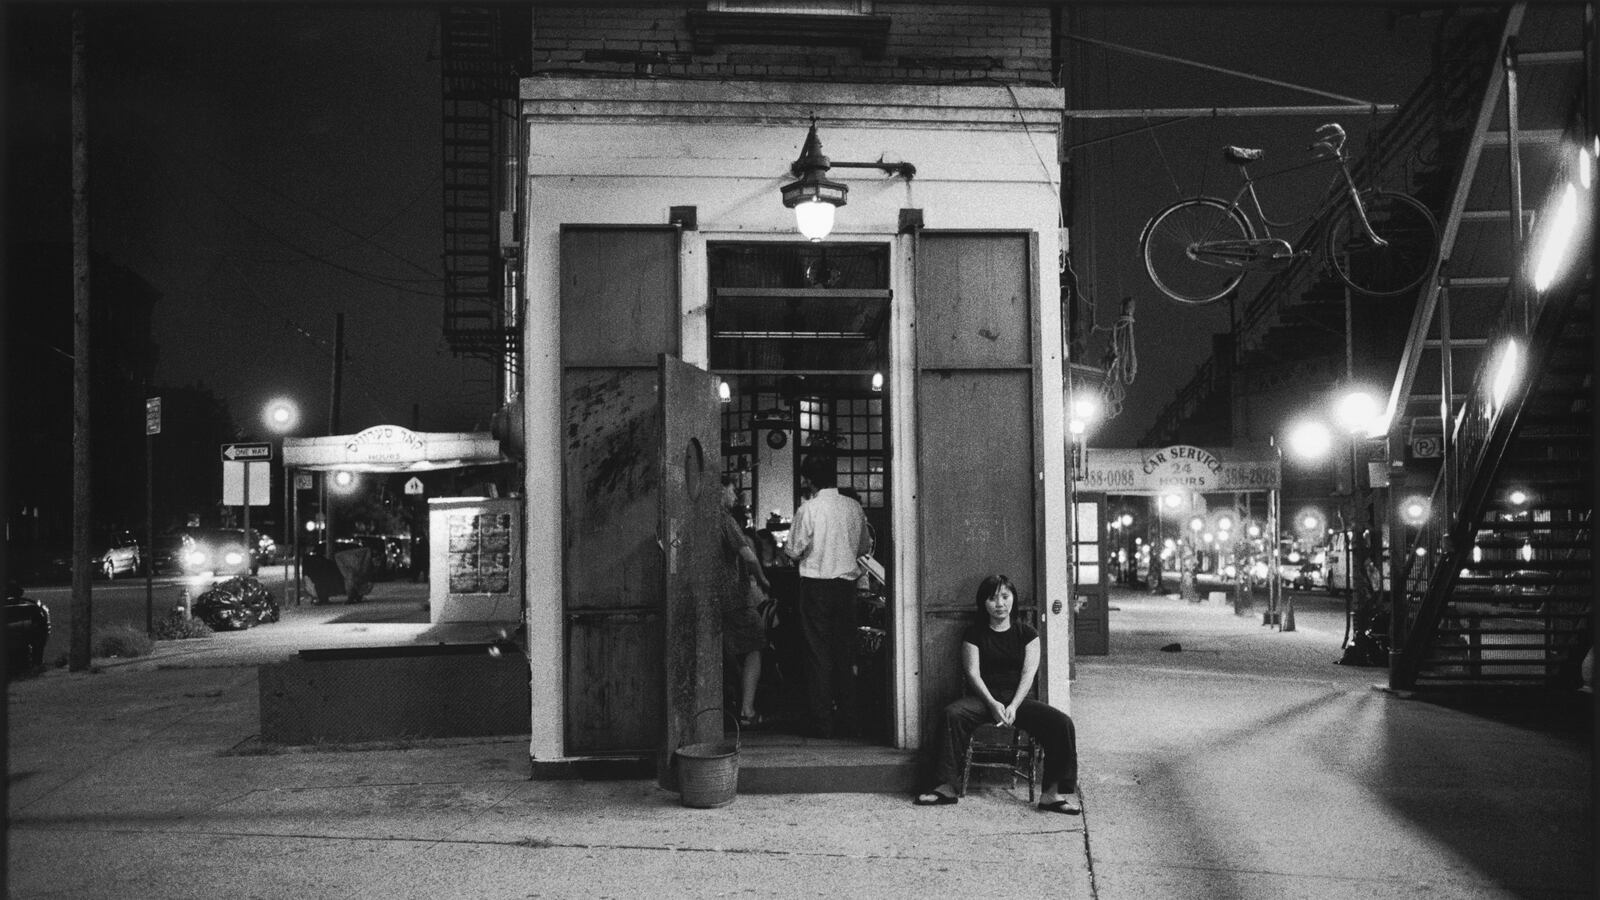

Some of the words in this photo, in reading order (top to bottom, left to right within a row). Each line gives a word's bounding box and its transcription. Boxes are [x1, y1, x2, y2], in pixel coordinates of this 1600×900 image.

[235, 447, 249, 457] ONE
[251, 447, 267, 456] WAY
[1143, 452, 1167, 475] CAR
[1170, 447, 1223, 476] SERVICE
[1170, 462, 1193, 475] 24
[1159, 476, 1206, 486] HOURS
